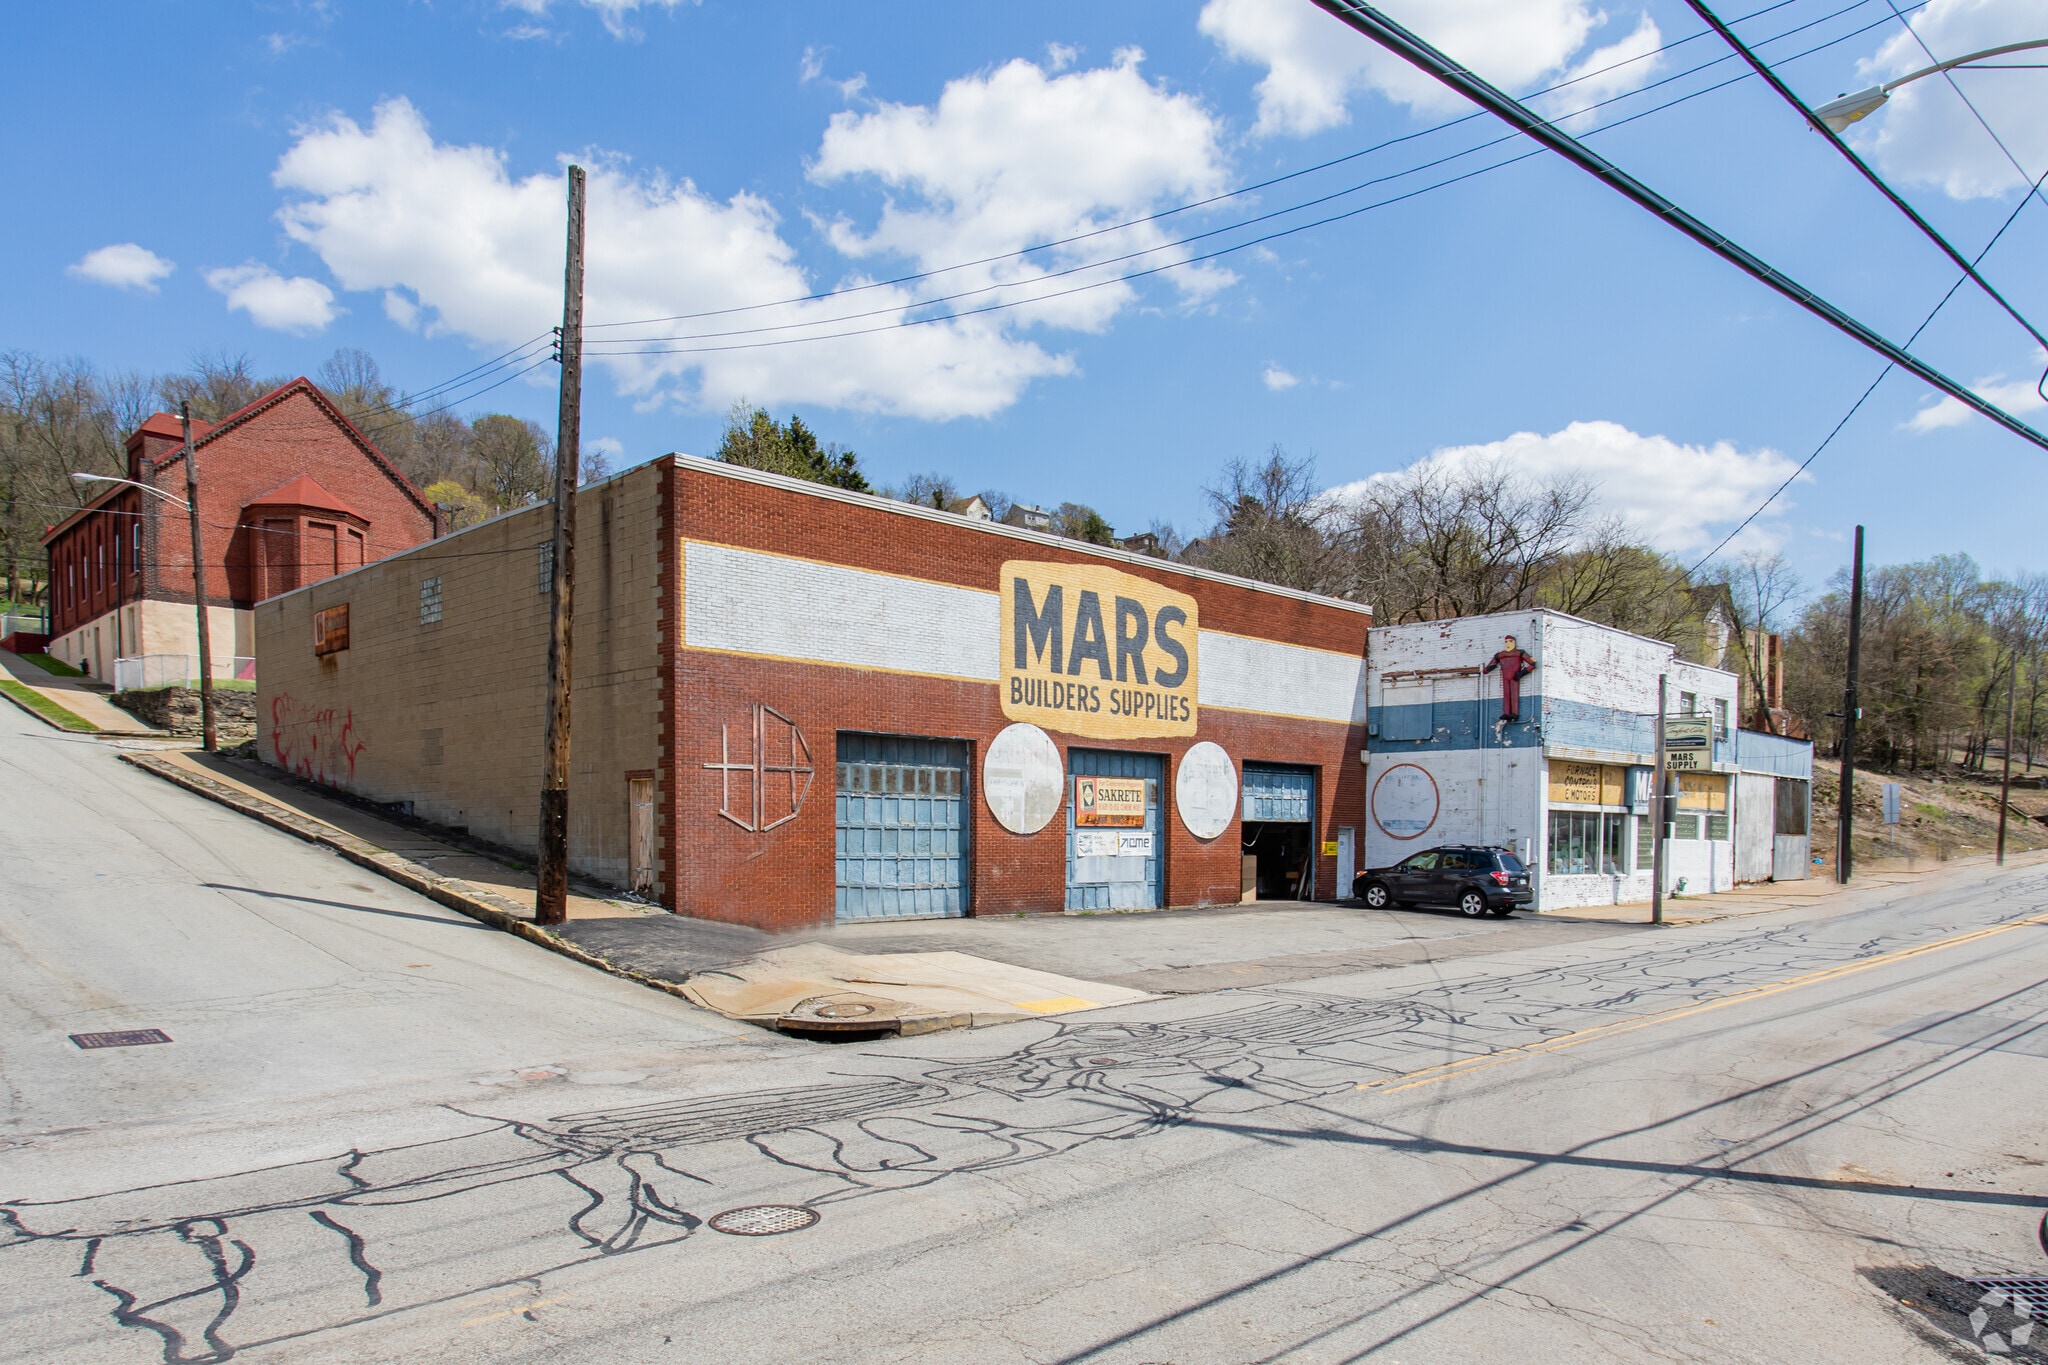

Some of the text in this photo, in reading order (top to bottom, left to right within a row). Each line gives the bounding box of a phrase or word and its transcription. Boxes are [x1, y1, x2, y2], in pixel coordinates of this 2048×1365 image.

[1014, 577, 1188, 688] MARS
[1011, 677, 1190, 722] BUILDERS SUPPLIES
[1671, 753, 1694, 761] MARS
[1566, 765, 1597, 777] FURNACE
[1666, 761, 1698, 769] SUPPLY
[1564, 776, 1597, 789] CONTROLS
[1099, 789, 1141, 802] SAKRETE
[1571, 790, 1596, 801] MOTORS
